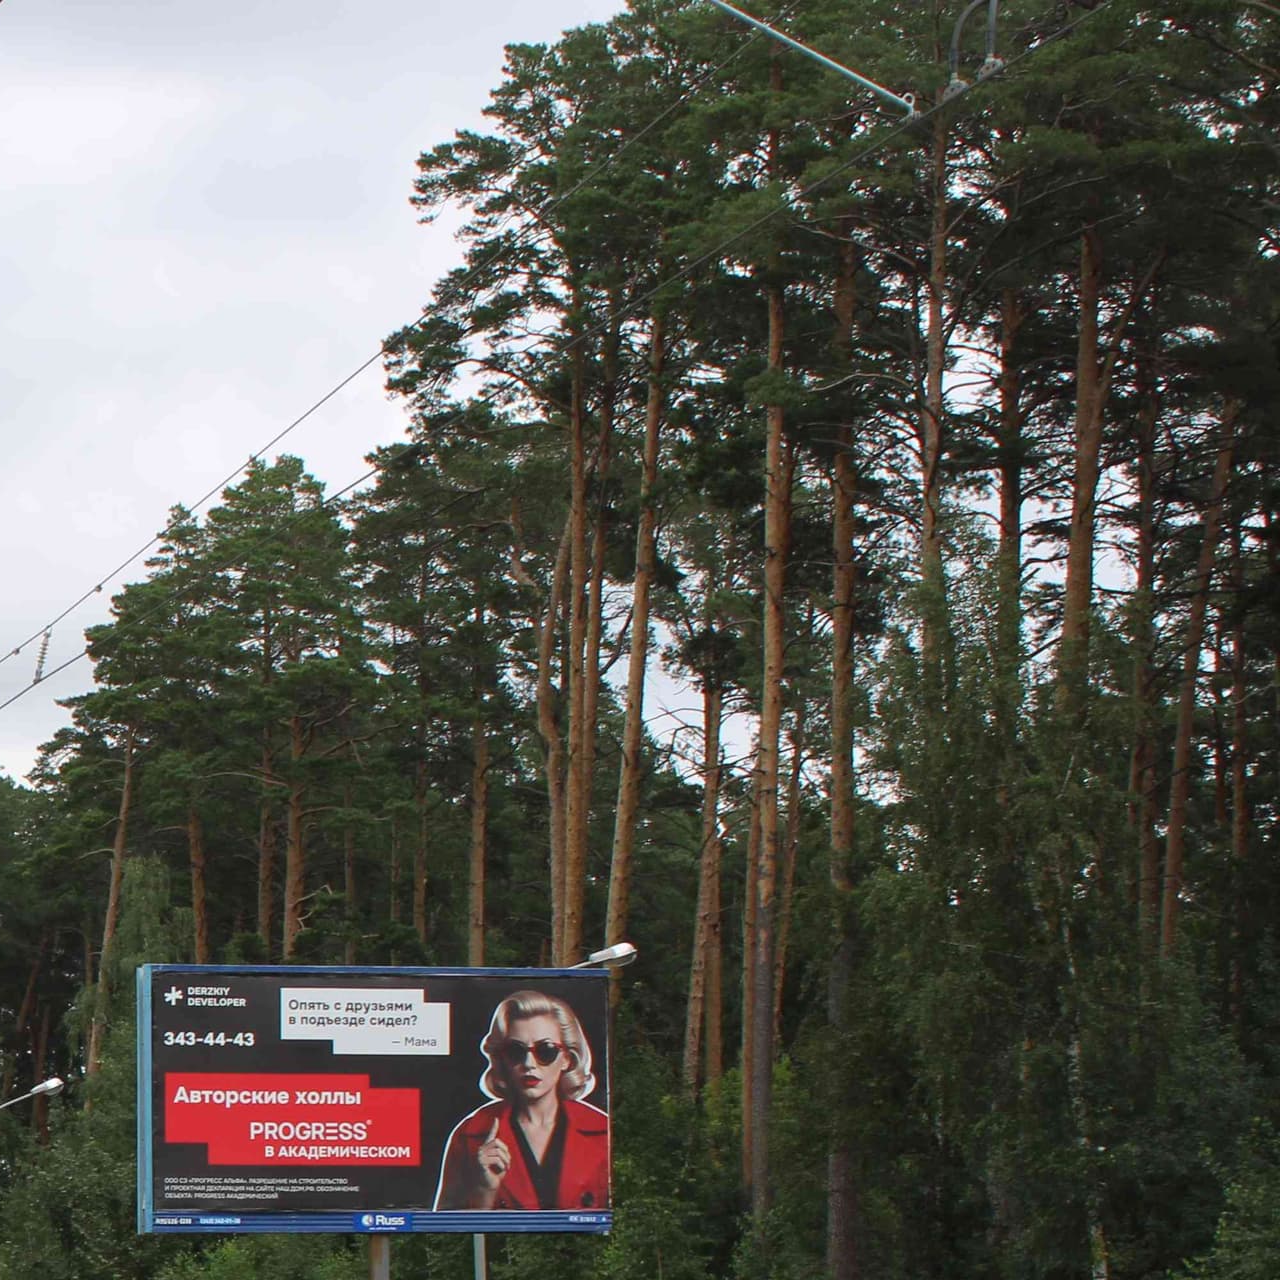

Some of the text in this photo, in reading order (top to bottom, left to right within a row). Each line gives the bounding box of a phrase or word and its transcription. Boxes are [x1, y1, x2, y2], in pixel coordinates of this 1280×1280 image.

[187, 986, 231, 996] DERZKIY
[187, 997, 247, 1007] DEVELOPER
[289, 999, 413, 1014] Опять с друзьями
[289, 1015, 418, 1027] в подъезде сидел?
[163, 1031, 255, 1047] 343-44-43
[404, 1036, 437, 1047] Мама
[173, 1086, 361, 1108] Авторские холлы
[249, 1121, 368, 1141] PROGRESS
[264, 1145, 411, 1160] В АКАДЕМИЧЕСКОМ
[375, 1214, 405, 1226] Russ
